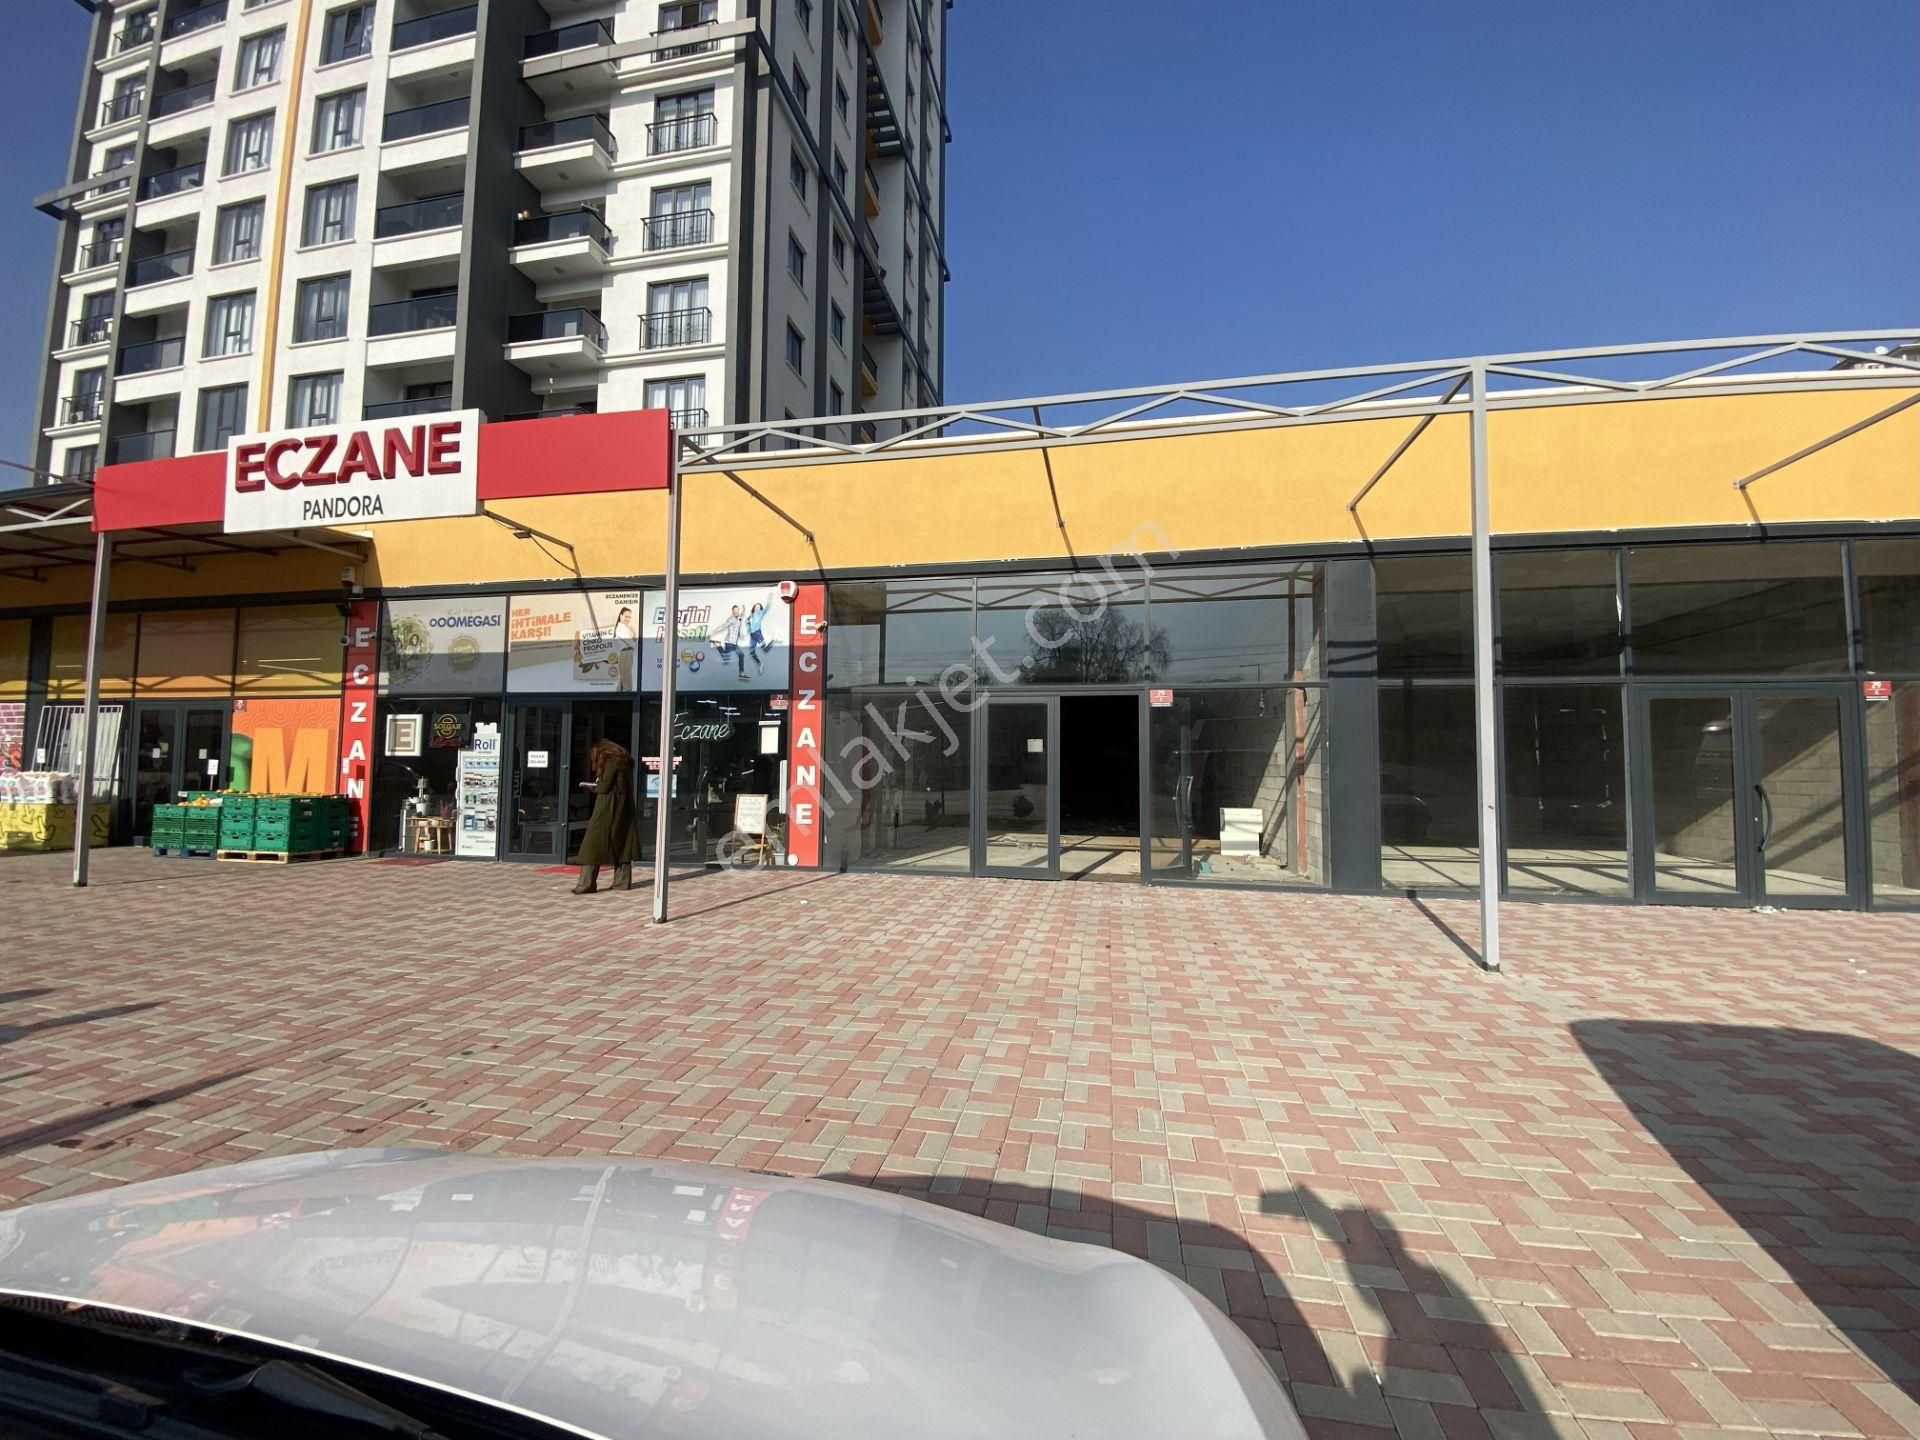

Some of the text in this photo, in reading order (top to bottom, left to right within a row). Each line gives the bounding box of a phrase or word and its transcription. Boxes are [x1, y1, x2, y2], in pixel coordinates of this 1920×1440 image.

[235, 421, 462, 493] ECZANE
[302, 494, 384, 521] PANDORA
[511, 608, 530, 617] HER
[511, 626, 552, 640] KARŞI!
[795, 614, 818, 825] ECZANE
